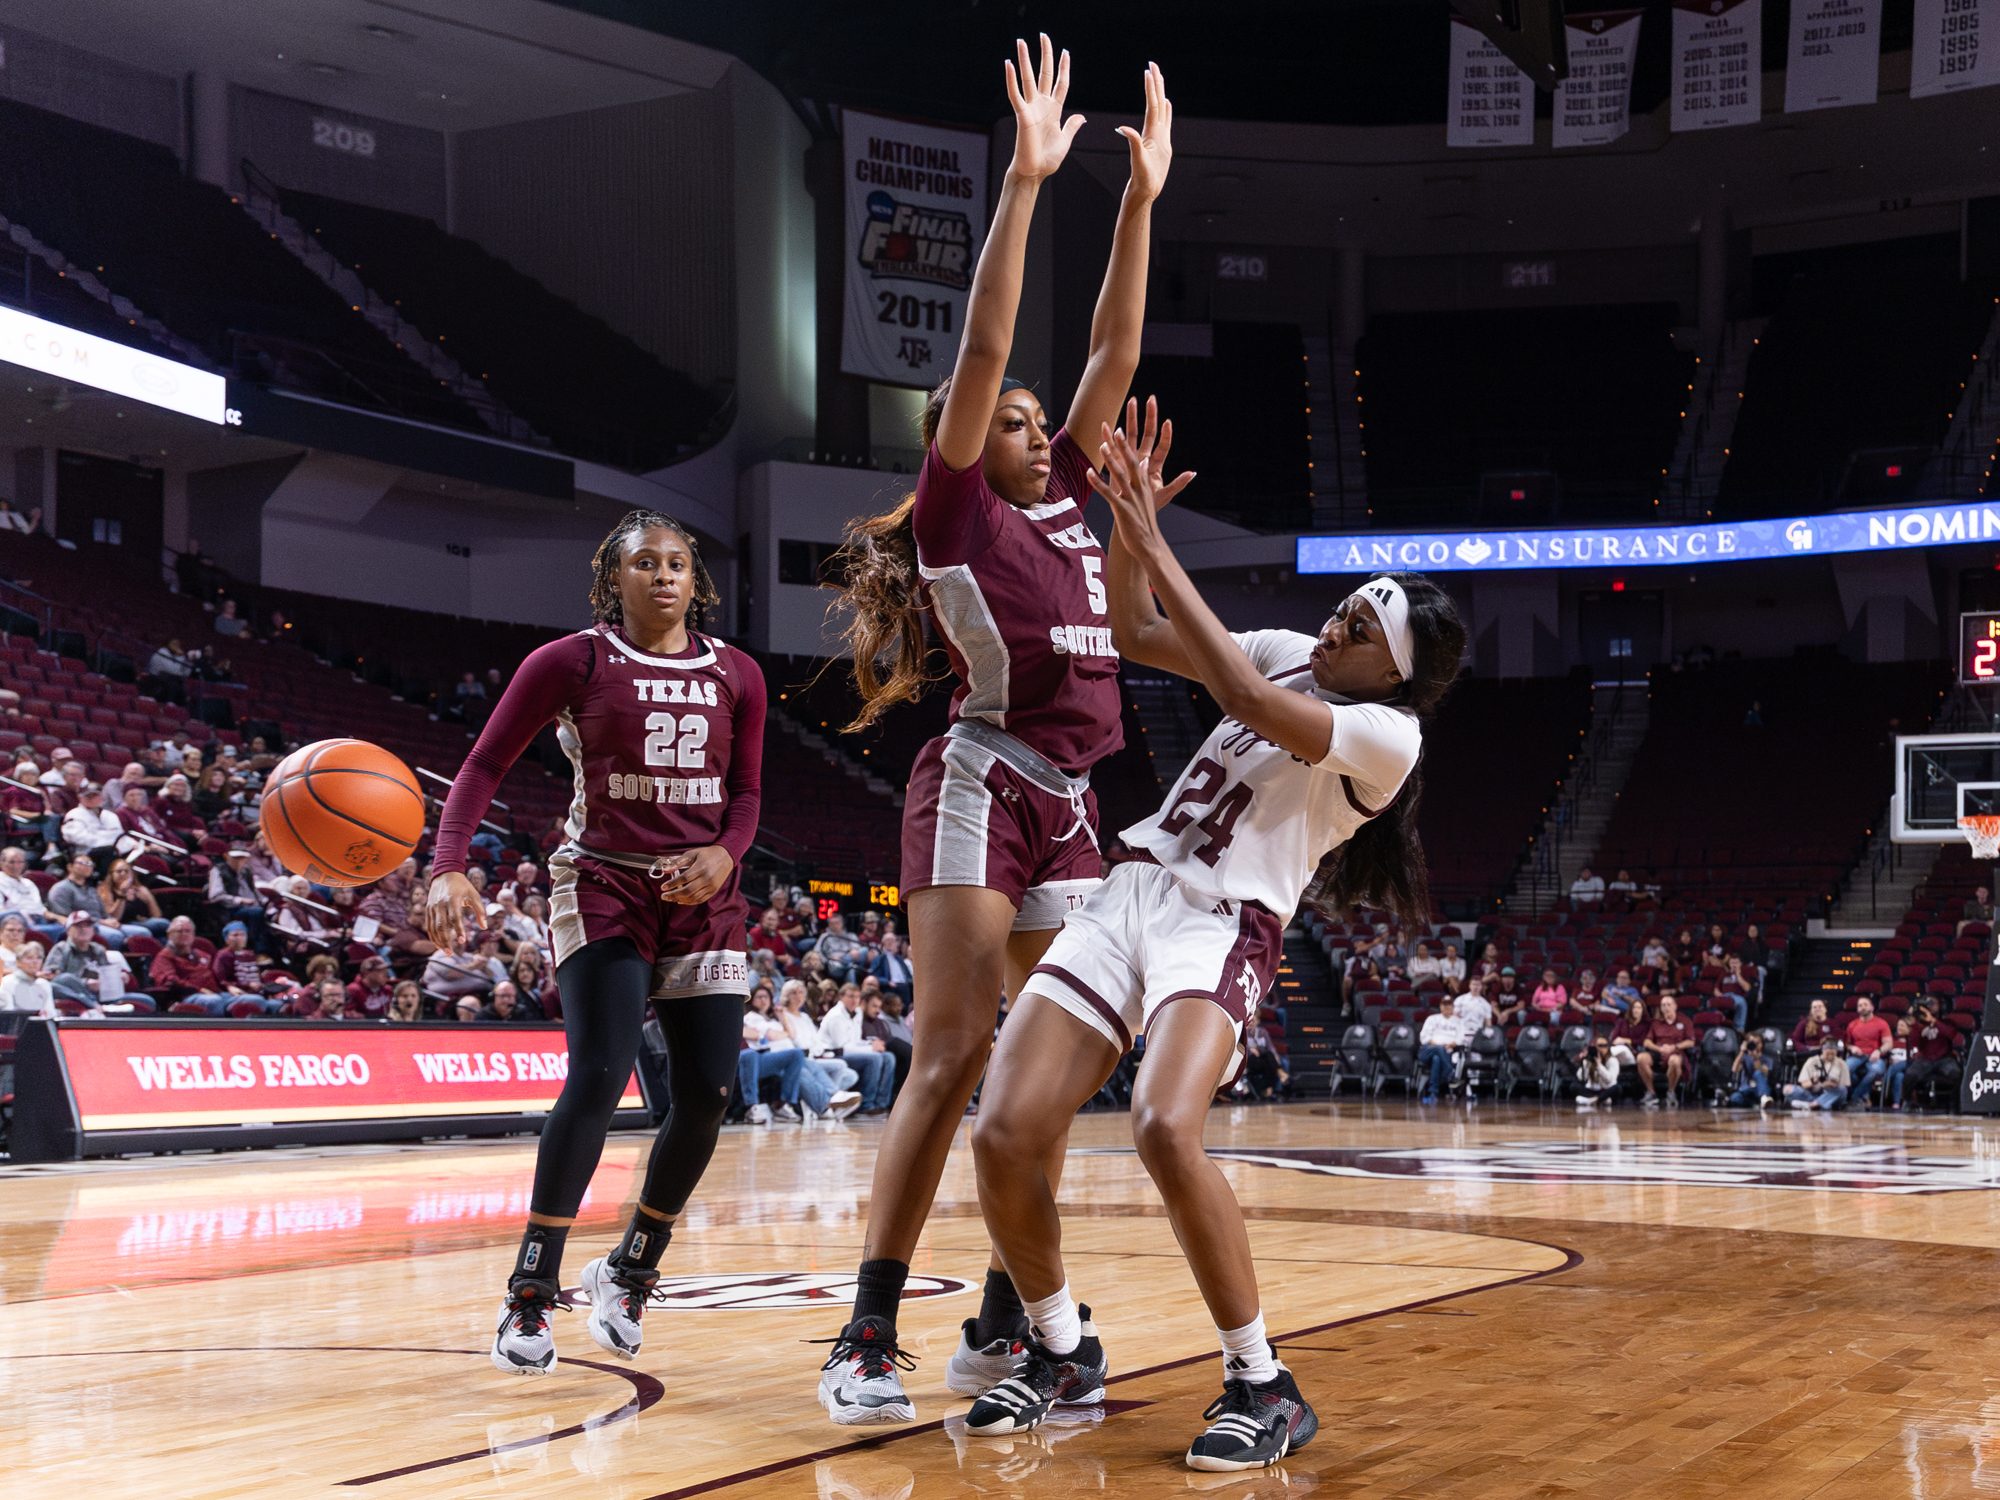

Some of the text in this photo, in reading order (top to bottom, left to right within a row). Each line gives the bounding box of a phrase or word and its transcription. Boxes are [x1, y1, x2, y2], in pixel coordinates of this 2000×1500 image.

[1941, 13, 1979, 35] 1985
[1939, 52, 1978, 75] 1997
[313, 122, 376, 156] 209
[869, 137, 961, 173] NATIONAL
[856, 159, 973, 199] CHAMPIONS
[893, 206, 967, 243] FINAL
[1218, 256, 1264, 278] 210
[1511, 264, 1549, 287] 211
[877, 291, 952, 333] 2011
[1344, 530, 1736, 567] ANCO INSURANCE
[1081, 555, 1107, 615] 5
[633, 679, 718, 707] TEXAS
[644, 711, 709, 769] 22
[1157, 757, 1254, 869] 24
[126, 1053, 370, 1090] WELLS FARGO
[412, 1052, 569, 1083] WELLS FAR
